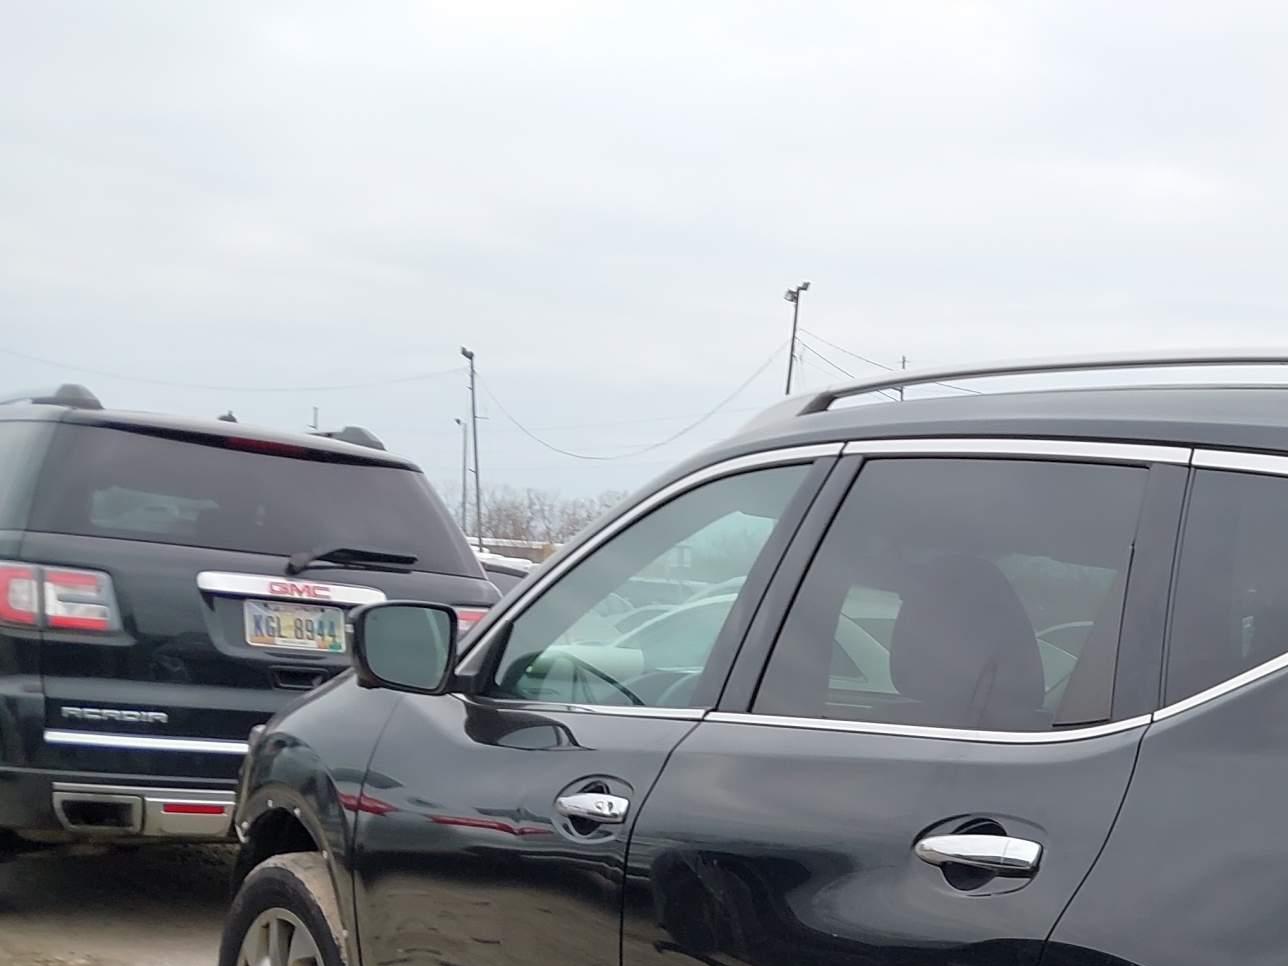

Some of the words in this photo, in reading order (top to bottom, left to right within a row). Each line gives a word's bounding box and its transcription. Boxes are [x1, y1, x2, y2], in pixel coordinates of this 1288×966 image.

[269, 580, 332, 599] GMC
[253, 614, 288, 638] KGL
[294, 618, 337, 644] 8944
[60, 705, 169, 724] ACADIA
